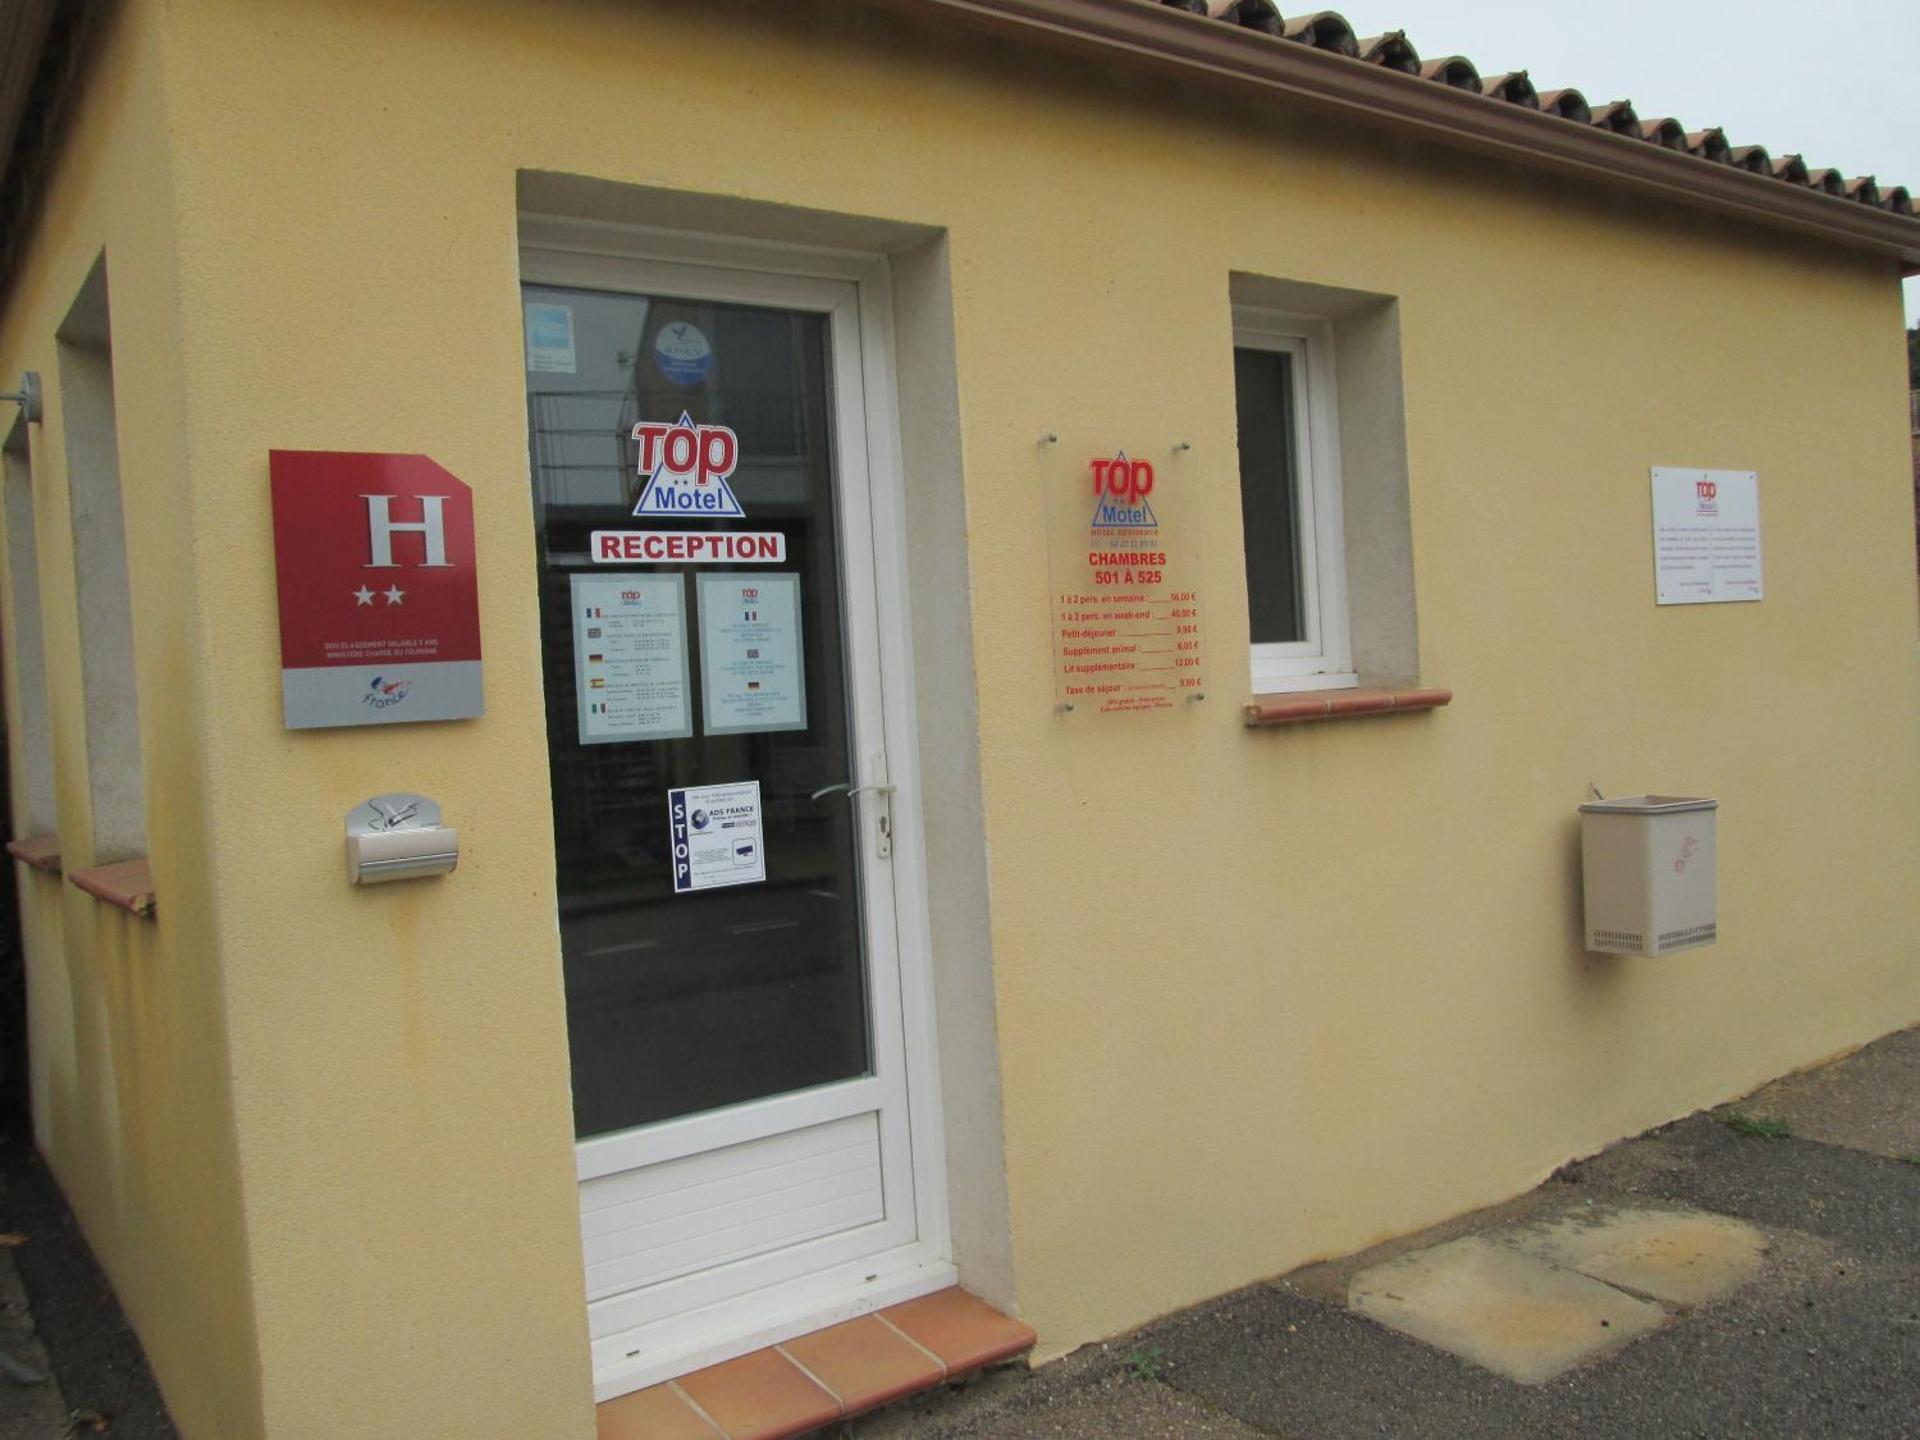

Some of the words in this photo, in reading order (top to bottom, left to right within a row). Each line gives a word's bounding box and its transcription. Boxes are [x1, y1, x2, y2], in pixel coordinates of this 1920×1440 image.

[655, 487, 723, 509] Motel
[1103, 505, 1147, 523] Motel
[358, 494, 456, 568] H
[600, 536, 778, 559] RECEPTION
[1089, 552, 1167, 566] CHAMBRES
[1095, 571, 1119, 584] 501
[1138, 571, 1162, 584] 525
[1073, 594, 1079, 603] 2
[1074, 612, 1079, 620] 2
[1111, 644, 1136, 653] animal
[1066, 686, 1083, 695] Taxe
[1085, 685, 1095, 694] de
[709, 808, 724, 816] ADS
[725, 805, 754, 814] FRANCE
[674, 804, 688, 879] STOP
